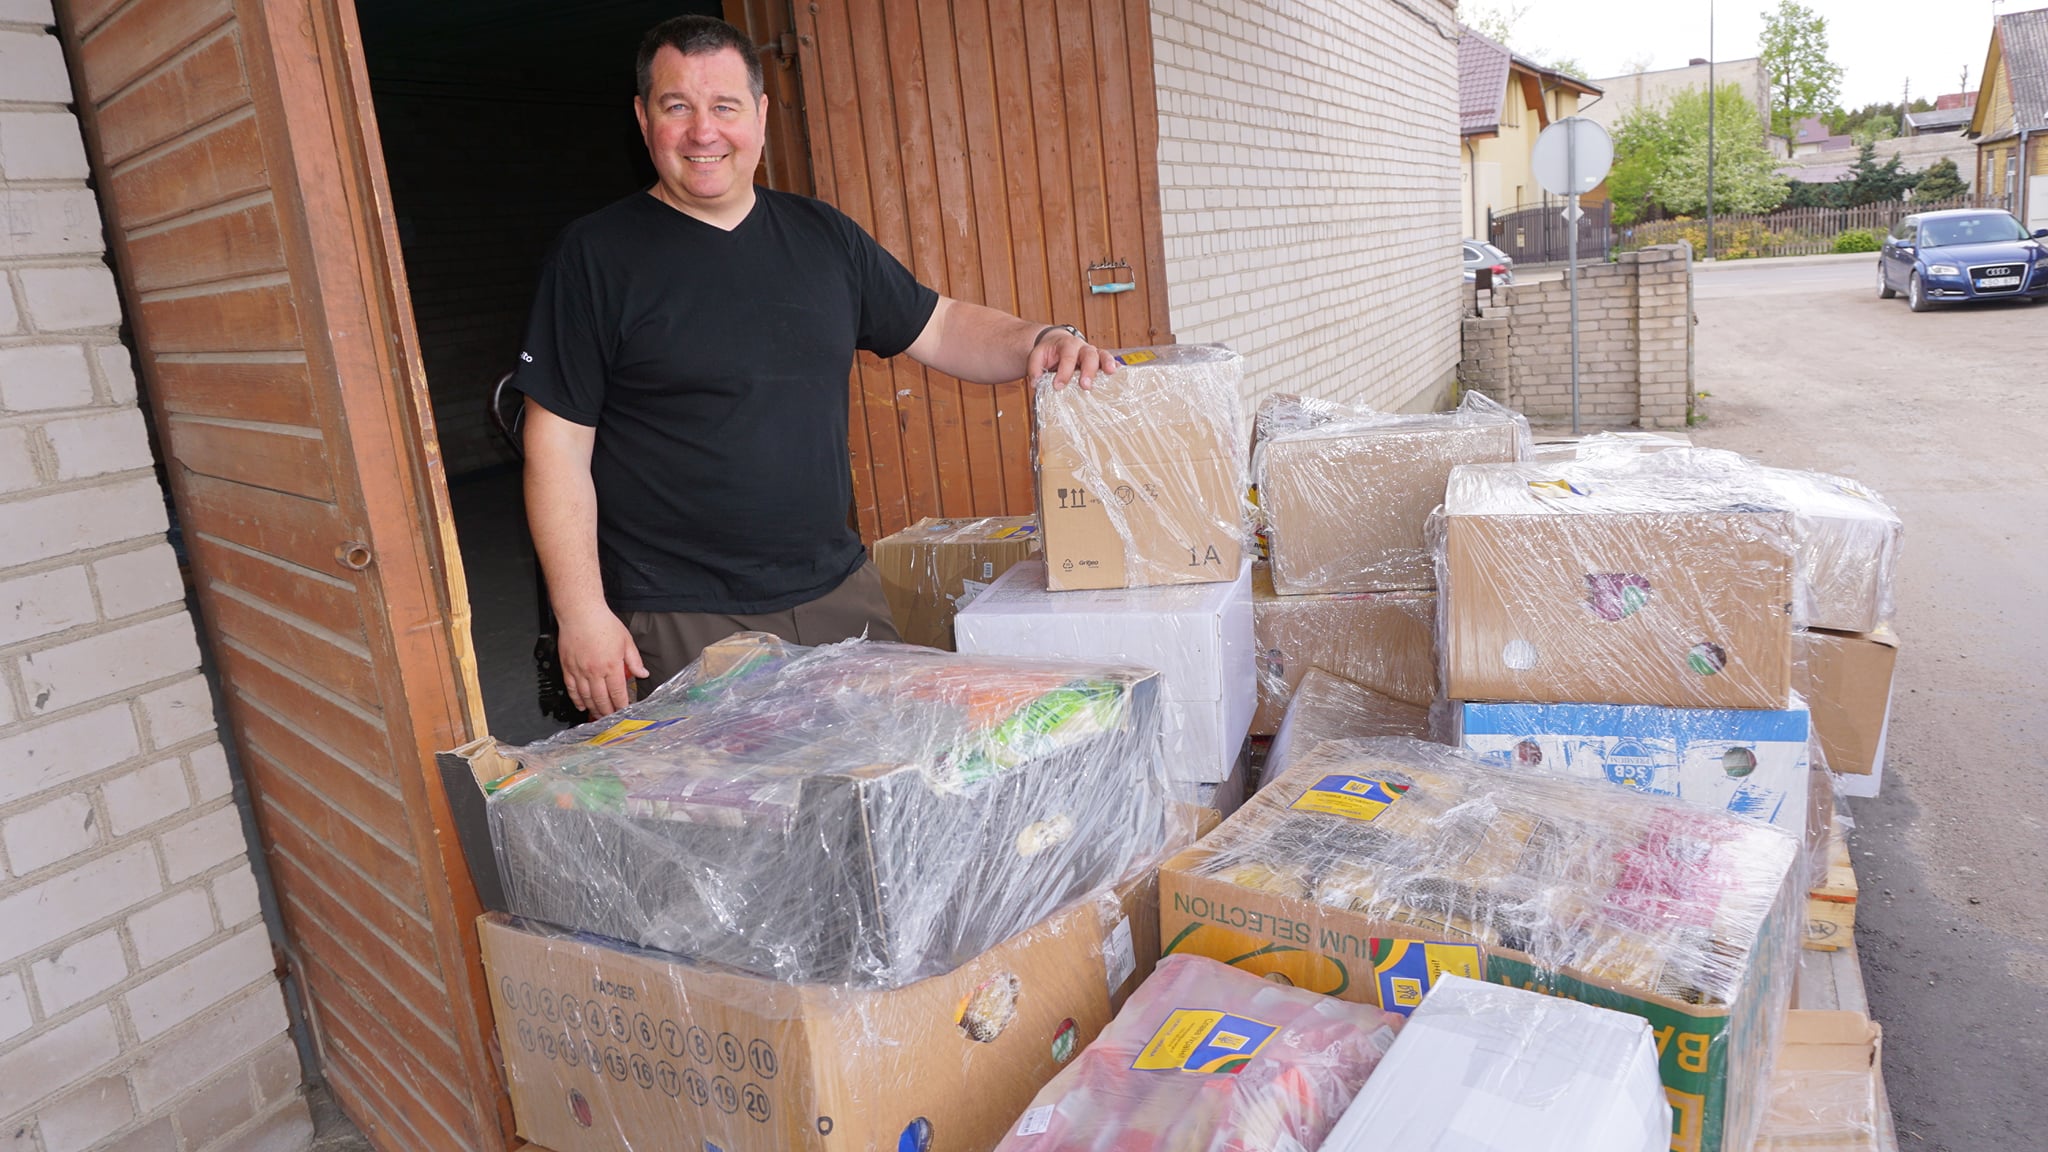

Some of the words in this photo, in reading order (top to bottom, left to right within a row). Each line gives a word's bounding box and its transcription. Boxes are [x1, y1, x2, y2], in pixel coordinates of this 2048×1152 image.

[1609, 756, 1651, 765] PREMIUM
[1613, 764, 1647, 778] SCB
[1174, 892, 1311, 945] SELECTION
[1320, 928, 1374, 960] IUM
[592, 977, 636, 1001] PACKER
[544, 996, 555, 1016] 2
[566, 1002, 577, 1022] 3
[590, 1009, 600, 1029] 4
[614, 1015, 625, 1036] 5
[640, 1021, 651, 1043] 6
[665, 1027, 675, 1049] 7
[694, 1034, 706, 1057] 8
[724, 1041, 737, 1063] 9
[750, 1047, 774, 1072] 10
[540, 1034, 555, 1054] 12
[606, 1053, 625, 1075] 15
[633, 1061, 651, 1079] 16
[659, 1069, 676, 1090] 17
[687, 1076, 706, 1099] 18
[715, 1083, 736, 1106] 19
[745, 1090, 768, 1115] 20
